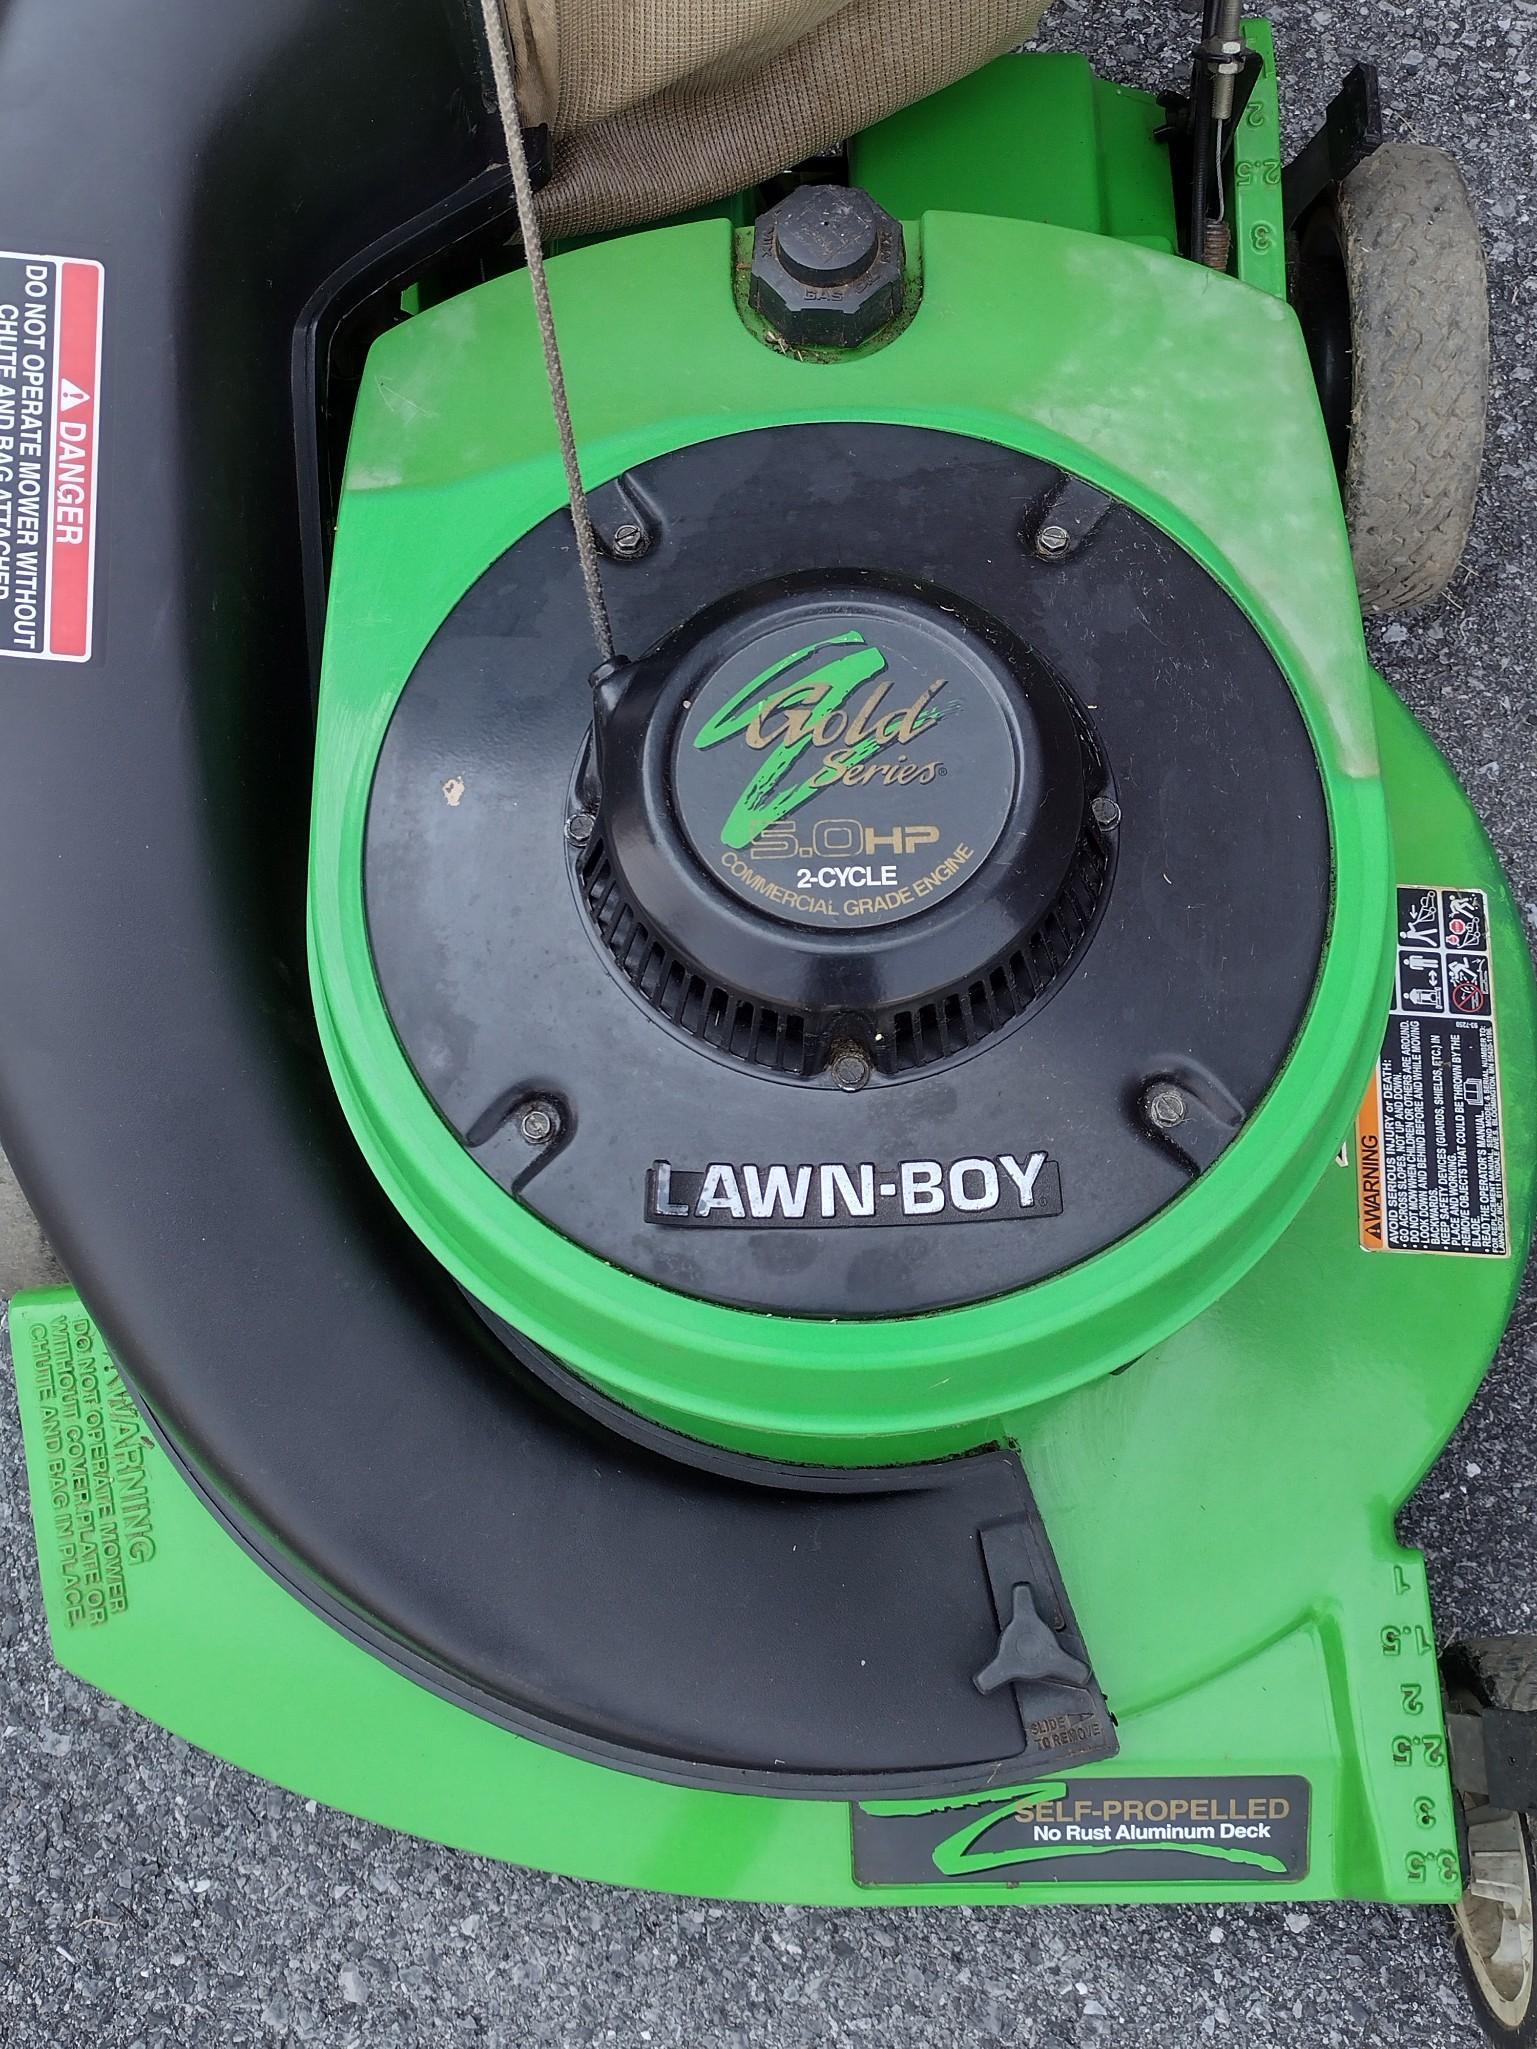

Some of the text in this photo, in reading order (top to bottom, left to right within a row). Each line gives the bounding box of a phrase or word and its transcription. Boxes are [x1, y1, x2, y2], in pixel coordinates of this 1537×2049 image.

[1246, 102, 1265, 127] 2
[1236, 159, 1281, 186] 2.5
[1250, 222, 1273, 253] 3
[804, 287, 843, 301] GAS
[0, 304, 19, 379] CHUTE
[0, 384, 16, 430] AND
[0, 435, 14, 482] BAG
[13, 265, 48, 649] DO NOT OPERATE MOWER WITHOUT
[56, 421, 87, 545] DANGER
[745, 679, 948, 750] Gold
[721, 842, 974, 916] COMMERCIAL GRADE ENGINE
[797, 866, 897, 888] 2-CYCLE
[1431, 1035, 1440, 1043] IN
[1433, 1068, 1443, 1105] SHIELDS,
[1400, 1021, 1419, 1242] DO NOT MOW WHEN CHILDREN OR OTHERS ARE AROUND.
[1411, 1021, 1429, 1243] LOOK DOWN AND BEHIND BEFORE AND WHILE MOVING
[1434, 1107, 1448, 1146] (GUARDS,
[1451, 1034, 1471, 1246] REMOVE OBJECTS THAT COULD BE THROWN BY THE
[1382, 1060, 1399, 1243] AVOID SERIOUS INJURY or DEATH:
[1393, 1073, 1409, 1242] GO ACROSS SLOPES, NOT UP AND DOWN.
[1437, 1148, 1447, 1184] DEVICES
[654, 1152, 1048, 1218] LAWN-BOY
[1362, 1136, 1380, 1222] WARNING
[1475, 1111, 1491, 1247] READ THE OPERATOR'S MANUAL.
[1429, 1188, 1440, 1244] BACKWARDS.
[1439, 1187, 1449, 1219] SAFETY
[1448, 1153, 1460, 1246] PLACE AND WORKING.
[1490, 1183, 1498, 1236] REPLACEMENT
[1441, 1222, 1450, 1244] KEEP
[1471, 1216, 1481, 1247] BLADE.
[29, 1323, 86, 1628] CHUTE AND BAG IN PLACE
[51, 1315, 108, 1626] WITHOUT COVER PLATE OR
[73, 1318, 129, 1614] DO NOT OPERATE MOWER
[1393, 1565, 1412, 1595] 1
[1380, 1625, 1431, 1656] 1.5
[1400, 1684, 1424, 1716] 2
[1030, 1716, 1066, 1735] SLIDE
[1034, 1723, 1101, 1750] TO REMOVE
[1392, 1735, 1444, 1767] 2.5
[1014, 1798, 1290, 1823] SELF-PROPELLED
[1414, 1796, 1438, 1829] 3
[1033, 1823, 1271, 1842] No Rust Aluminum Deck
[1405, 1850, 1458, 1884] 3.5
